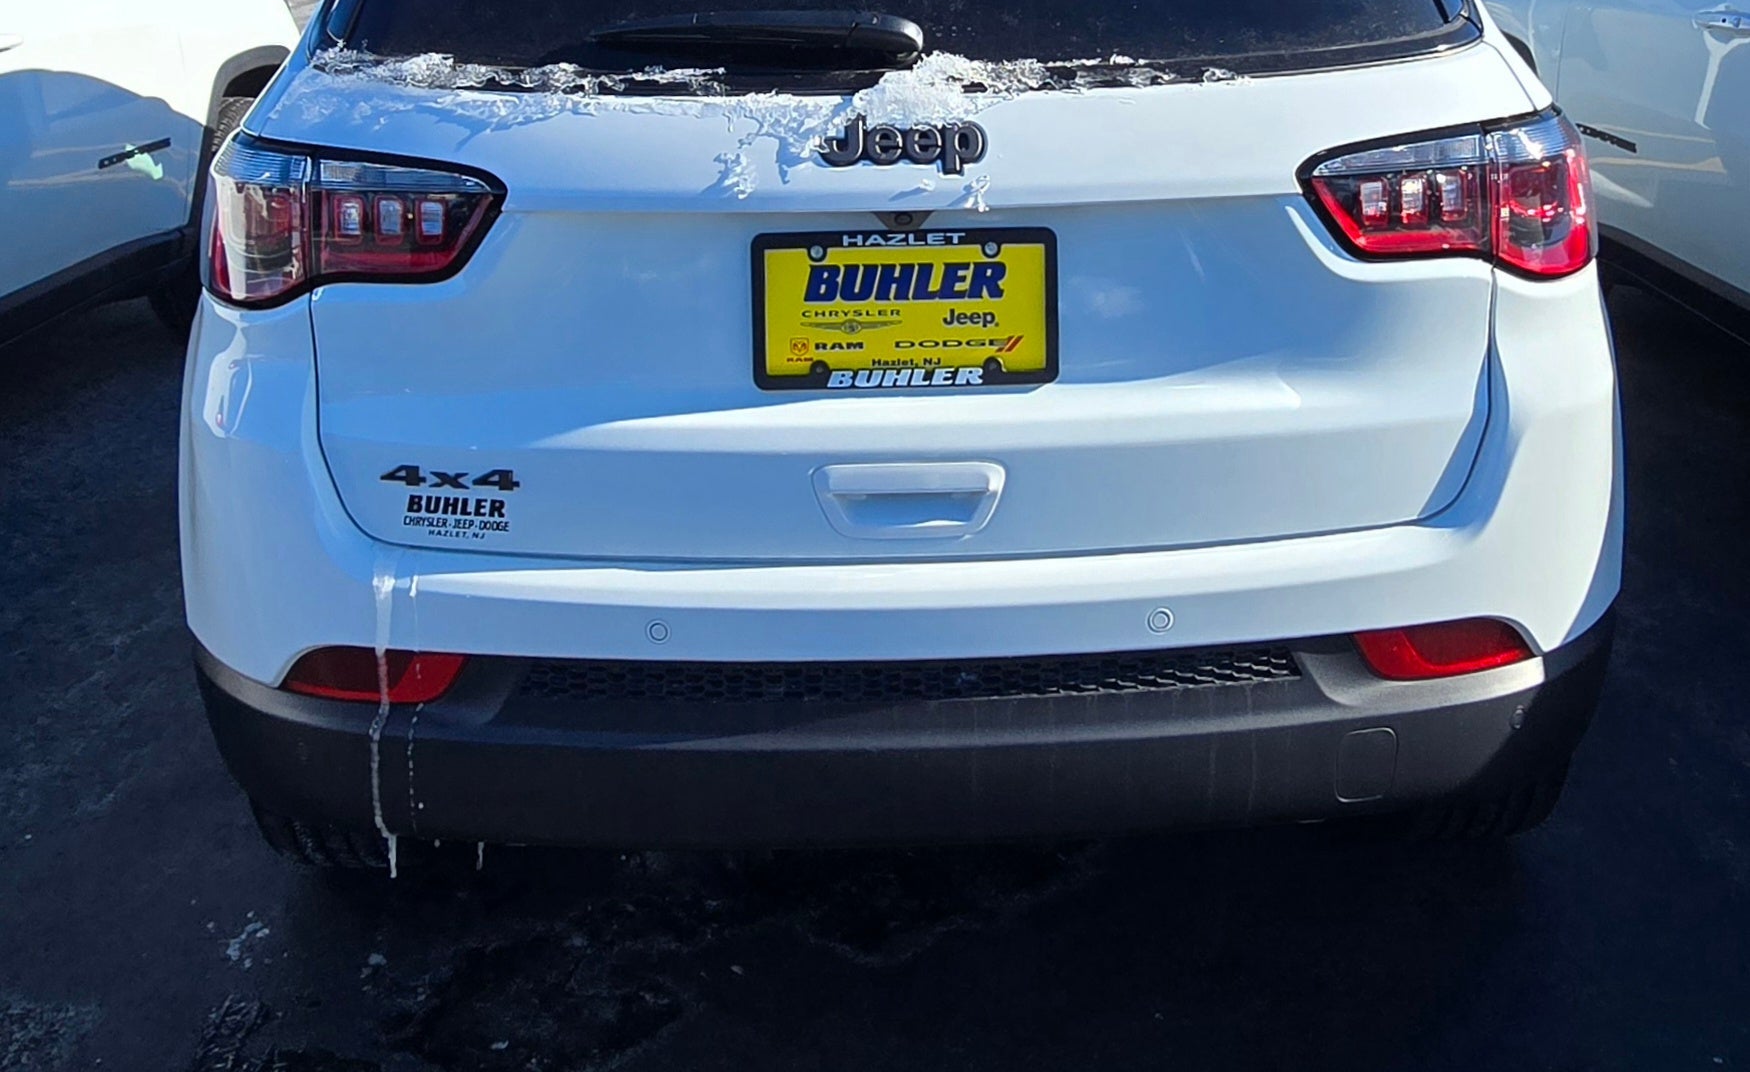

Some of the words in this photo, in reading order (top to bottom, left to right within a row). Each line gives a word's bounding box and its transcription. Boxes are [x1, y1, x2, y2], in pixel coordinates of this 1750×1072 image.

[819, 112, 988, 176] Jeep
[843, 232, 966, 247] HAZLET
[803, 262, 1007, 303] BUHLER
[801, 309, 901, 318] CHRYSLER
[942, 308, 997, 328] Jeep
[814, 341, 864, 351] RAM
[894, 338, 1007, 349] DODGE
[872, 358, 918, 368] Hazlet,
[923, 357, 941, 366] NJ
[827, 369, 984, 388] BUHLER
[380, 464, 521, 491] 4x4
[406, 494, 506, 518] BUHLER
[428, 529, 469, 539] HAZLET,
